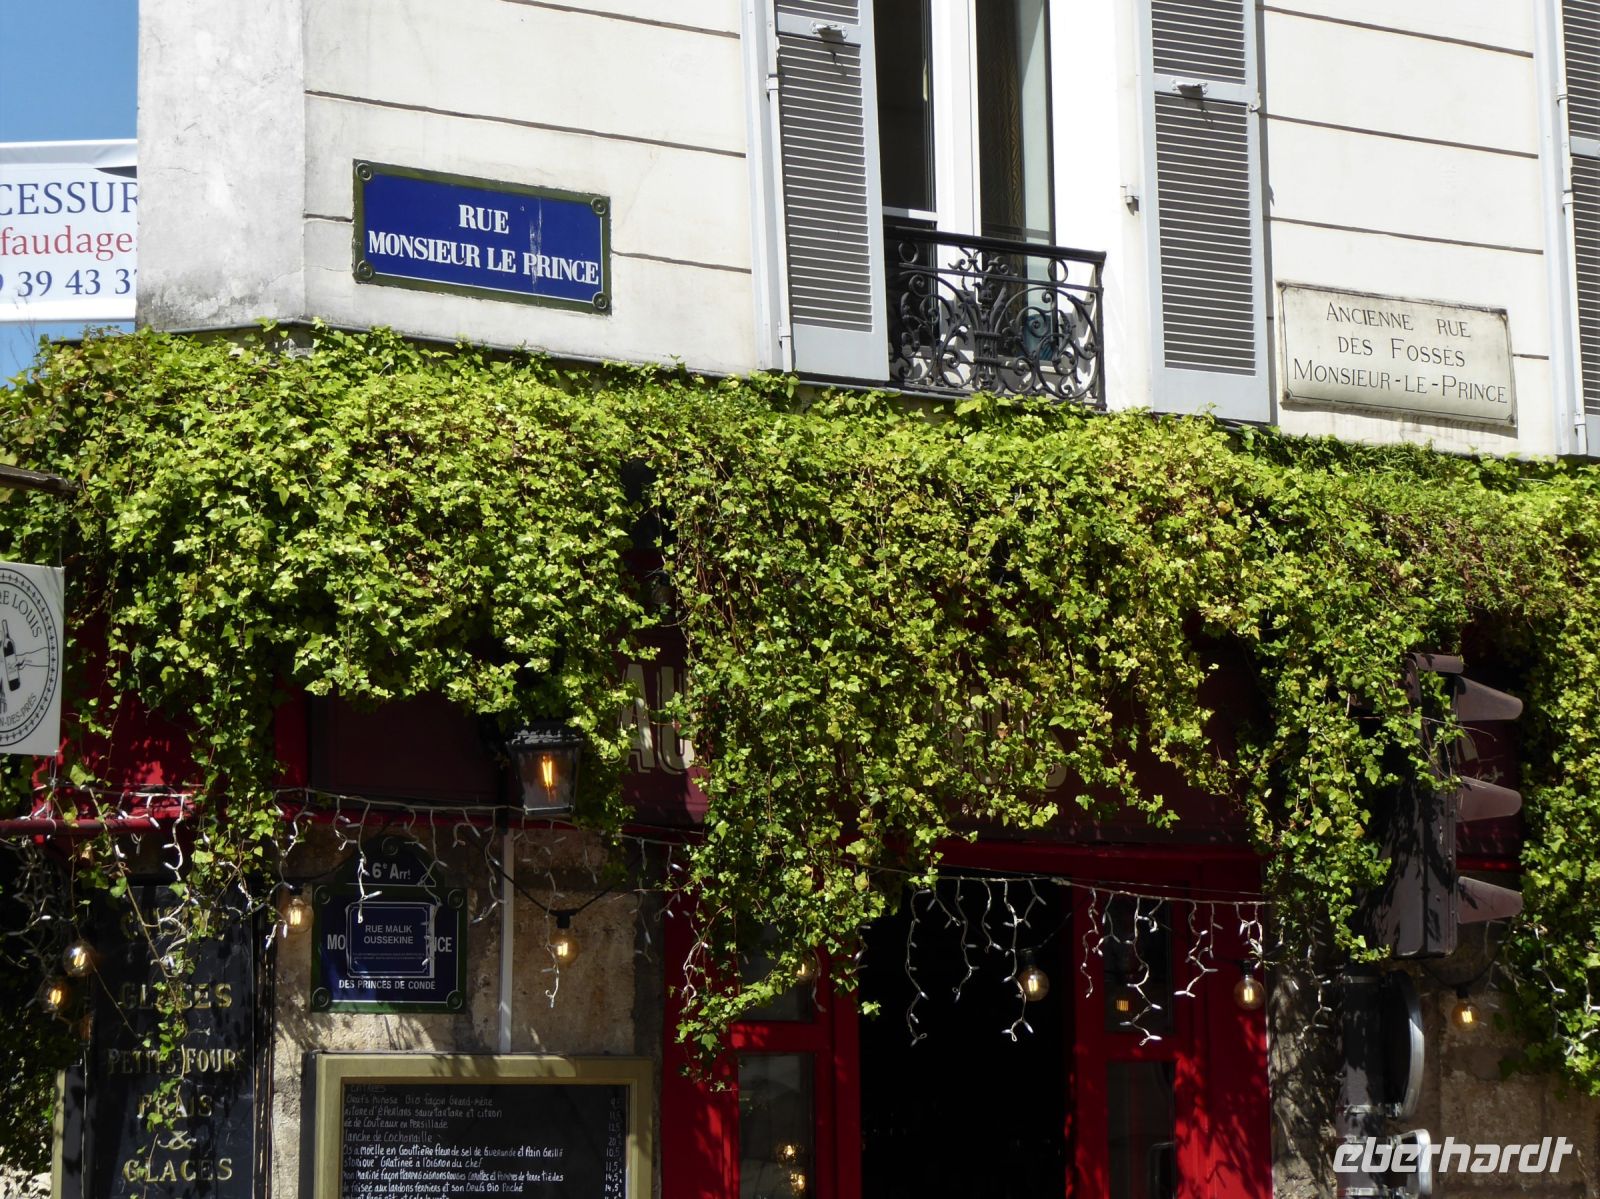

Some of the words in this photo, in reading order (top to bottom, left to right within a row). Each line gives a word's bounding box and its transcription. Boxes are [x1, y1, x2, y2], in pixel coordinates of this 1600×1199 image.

[459, 204, 509, 234] RUE
[1, 225, 137, 261] faudage
[368, 230, 481, 269] MONSIEUR
[486, 247, 516, 273] LE
[523, 252, 599, 285] PRINCE
[17, 270, 52, 297] 39
[64, 269, 101, 295] 43
[114, 268, 137, 294] 3
[1326, 302, 1414, 331] ANCIENNE
[1436, 318, 1471, 338] RUE
[1338, 336, 1373, 356] DES
[1294, 358, 1508, 404] MONSIEUR-LE-PRINCE
[0, 590, 10, 605] E
[12, 594, 43, 638] LOUIS
[363, 935, 415, 945] OUSSEKINE
[365, 924, 384, 933] RUE
[385, 924, 413, 933] MALIK
[338, 979, 355, 989] DES
[357, 980, 392, 989] PRINCES
[394, 980, 406, 990] DE
[157, 1130, 197, 1151] &
[122, 1158, 233, 1182] GLACES
[452, 1158, 462, 1168] du
[465, 1157, 484, 1168] chef
[452, 1184, 465, 1192] son
